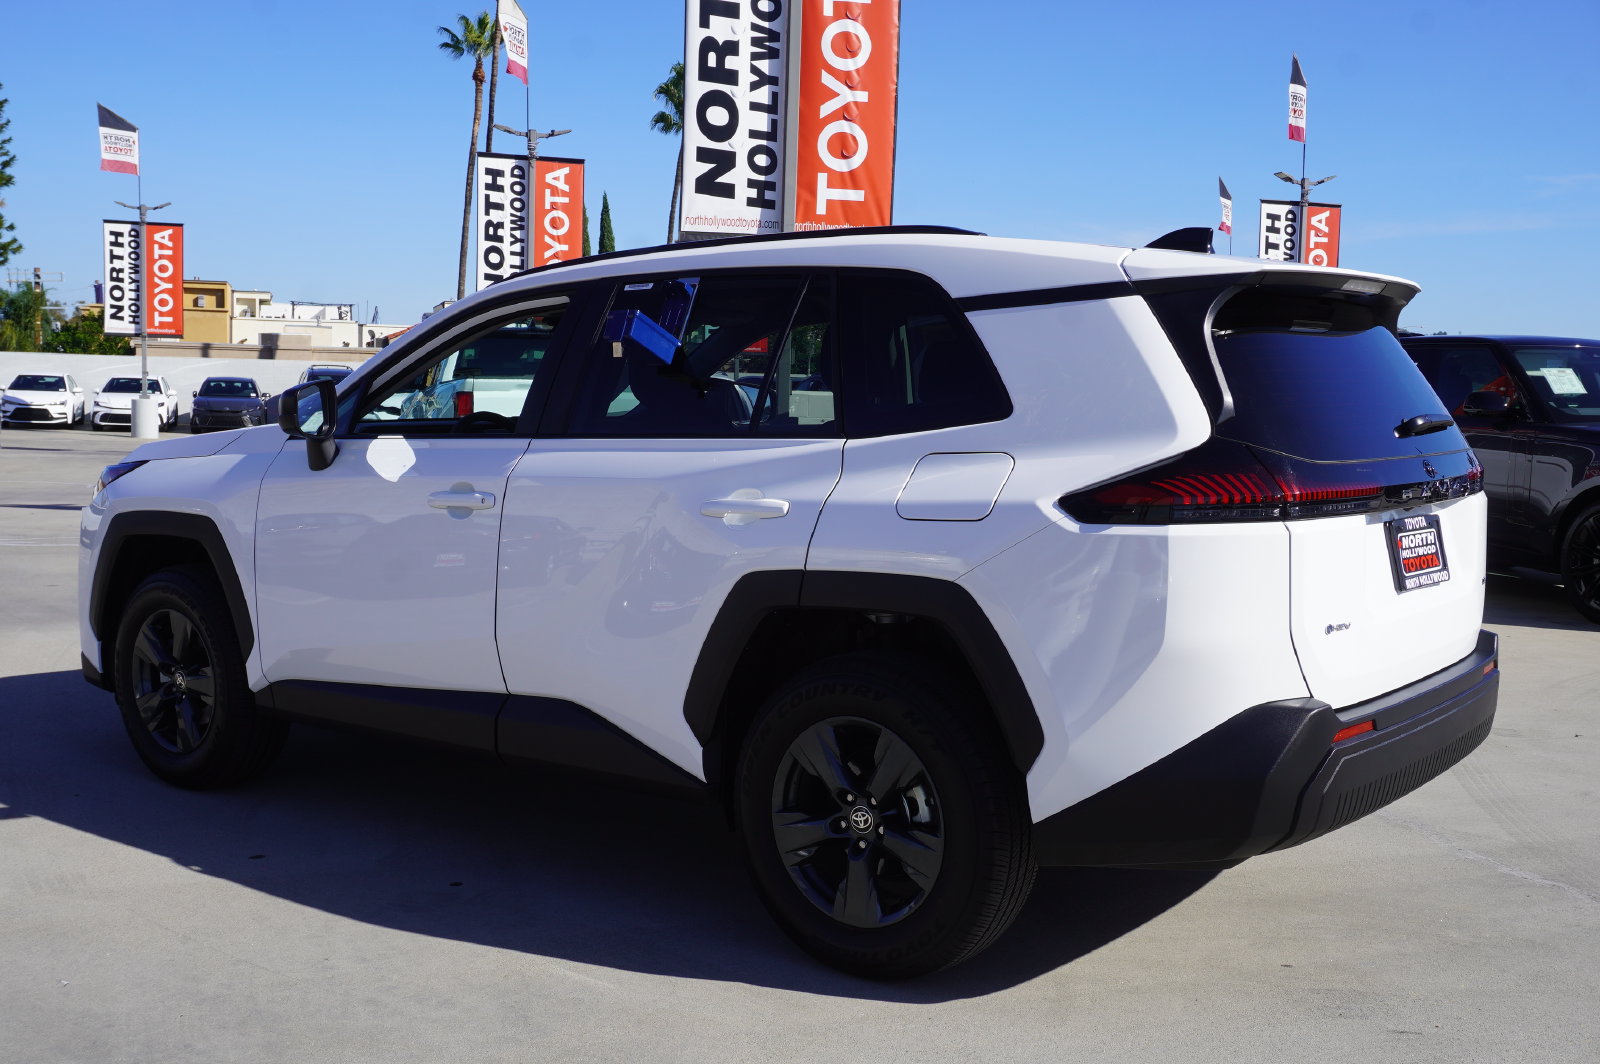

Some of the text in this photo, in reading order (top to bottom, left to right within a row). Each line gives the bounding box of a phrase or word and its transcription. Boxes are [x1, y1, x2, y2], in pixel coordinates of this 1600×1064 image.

[510, 165, 526, 276] LLYWOOD
[544, 167, 570, 265] YOTA
[685, 216, 779, 230] northhollywoodtoyota.com
[109, 230, 124, 321] NORTH
[128, 227, 140, 326] HOLLYWOOD
[154, 228, 173, 326] TOYOTA
[1405, 516, 1427, 530] TOYOTA
[1402, 532, 1434, 548] NORTH
[1402, 545, 1436, 558] HOLLYWOOD
[1403, 554, 1440, 573] TOYOTA
[1406, 571, 1448, 589] NORTH HOLLYWOOD
